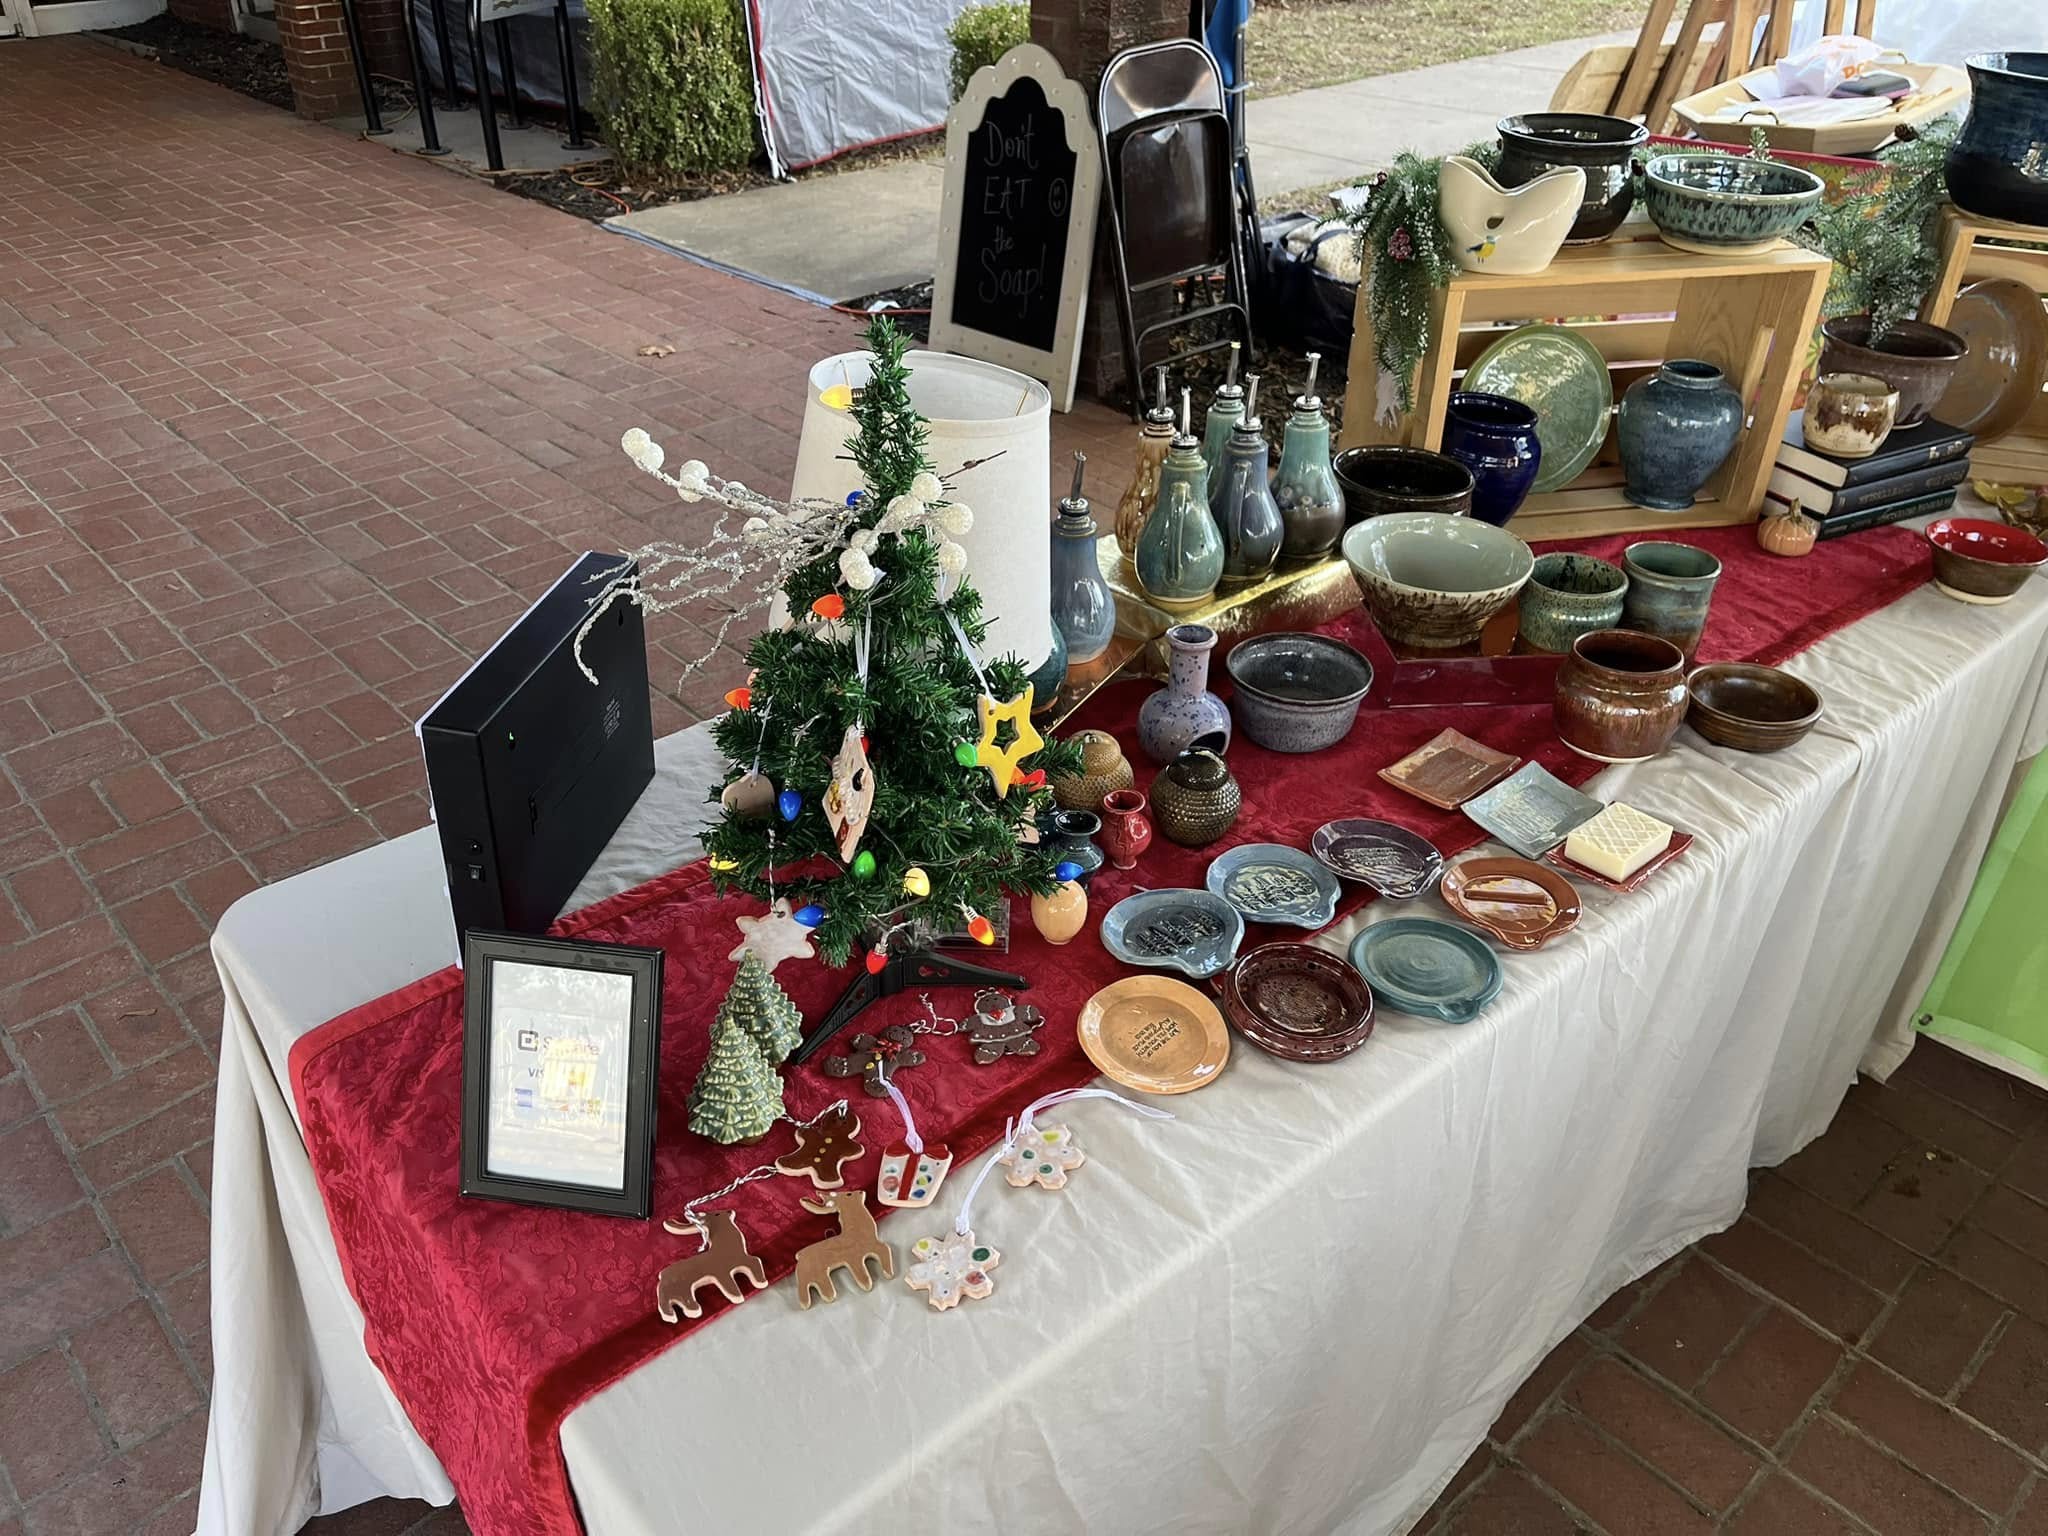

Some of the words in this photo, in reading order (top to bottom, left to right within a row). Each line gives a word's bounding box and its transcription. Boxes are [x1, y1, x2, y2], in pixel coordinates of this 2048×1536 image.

[984, 113, 1039, 169] Don't
[984, 175, 1033, 220] EAT
[993, 225, 1014, 253] the
[978, 242, 1047, 319] Soap!
